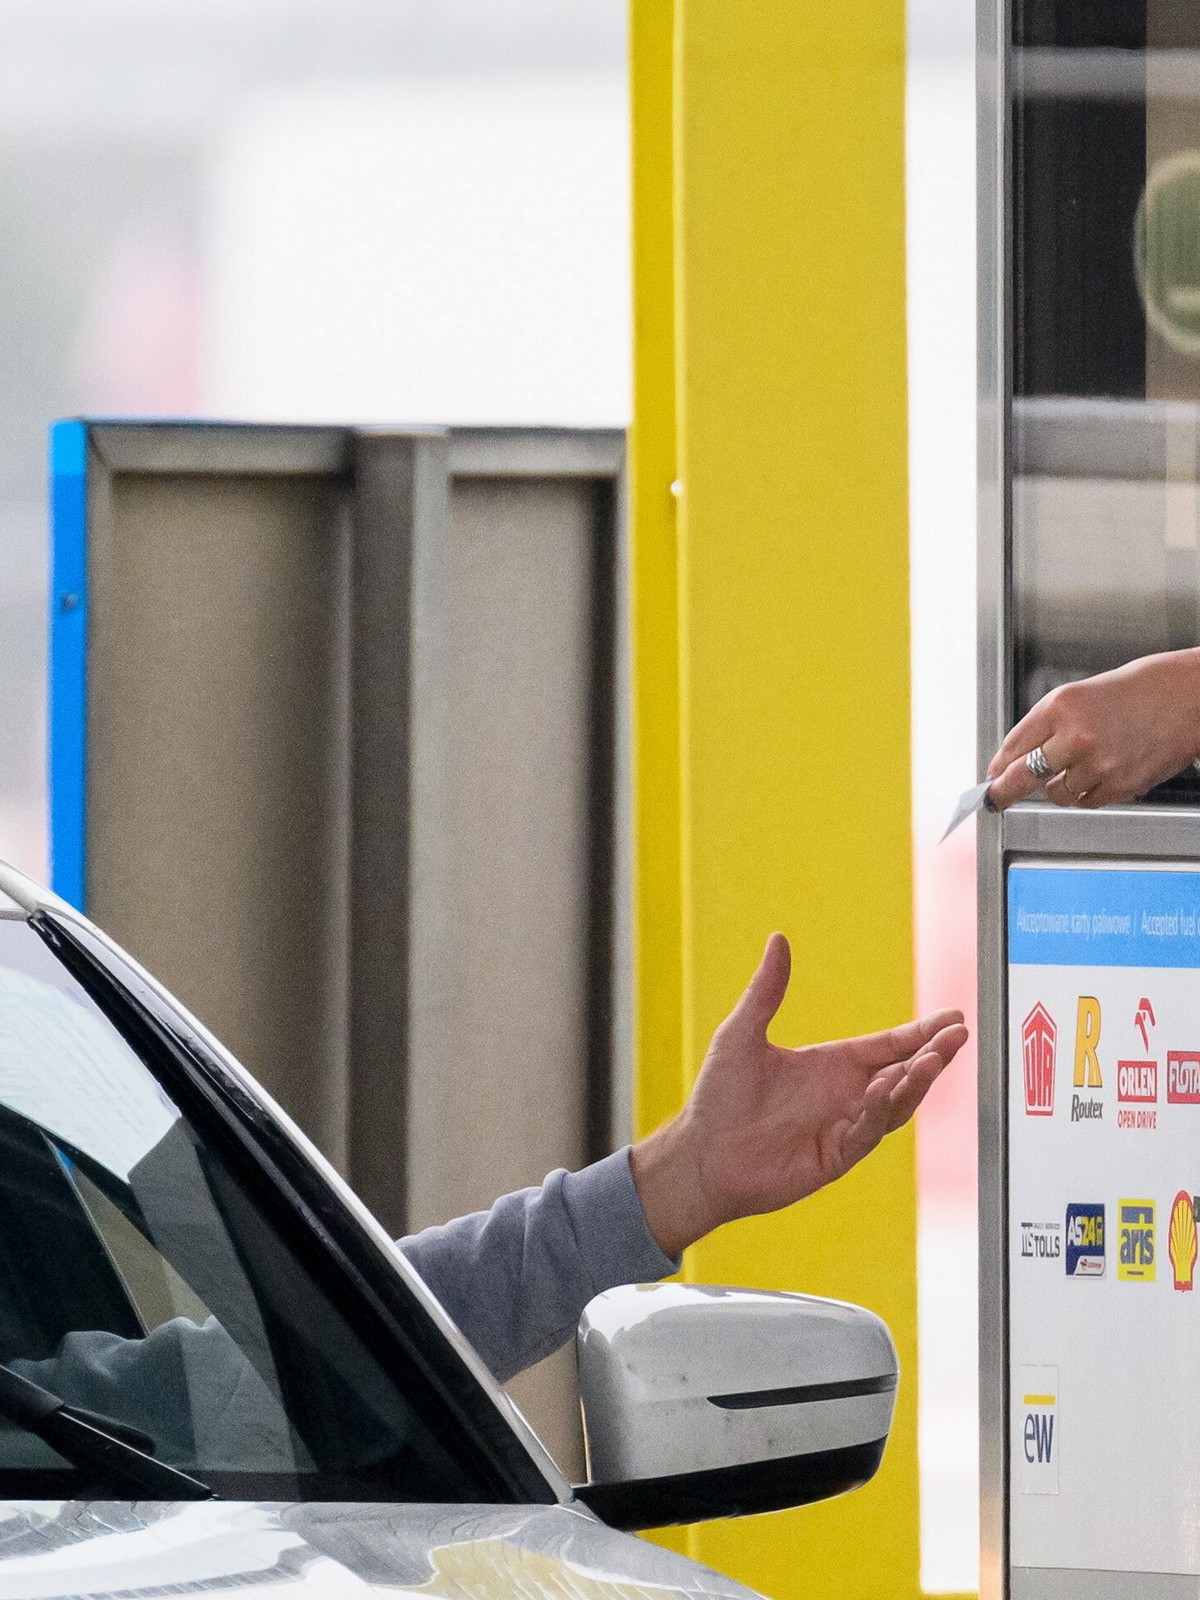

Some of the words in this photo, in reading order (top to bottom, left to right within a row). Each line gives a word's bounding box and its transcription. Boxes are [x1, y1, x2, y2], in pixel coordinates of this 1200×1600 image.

[1017, 907, 1070, 938] Akceptowane
[1141, 909, 1178, 941] Accepted
[1179, 908, 1196, 937] fuel
[1119, 1065, 1157, 1097] ORLEN
[1071, 1094, 1103, 1122] Routex
[1117, 1110, 1136, 1128] OPEN
[1136, 1110, 1157, 1129] DRIVE
[1034, 1235, 1061, 1258] TOLLS
[1024, 1413, 1054, 1463] ew
